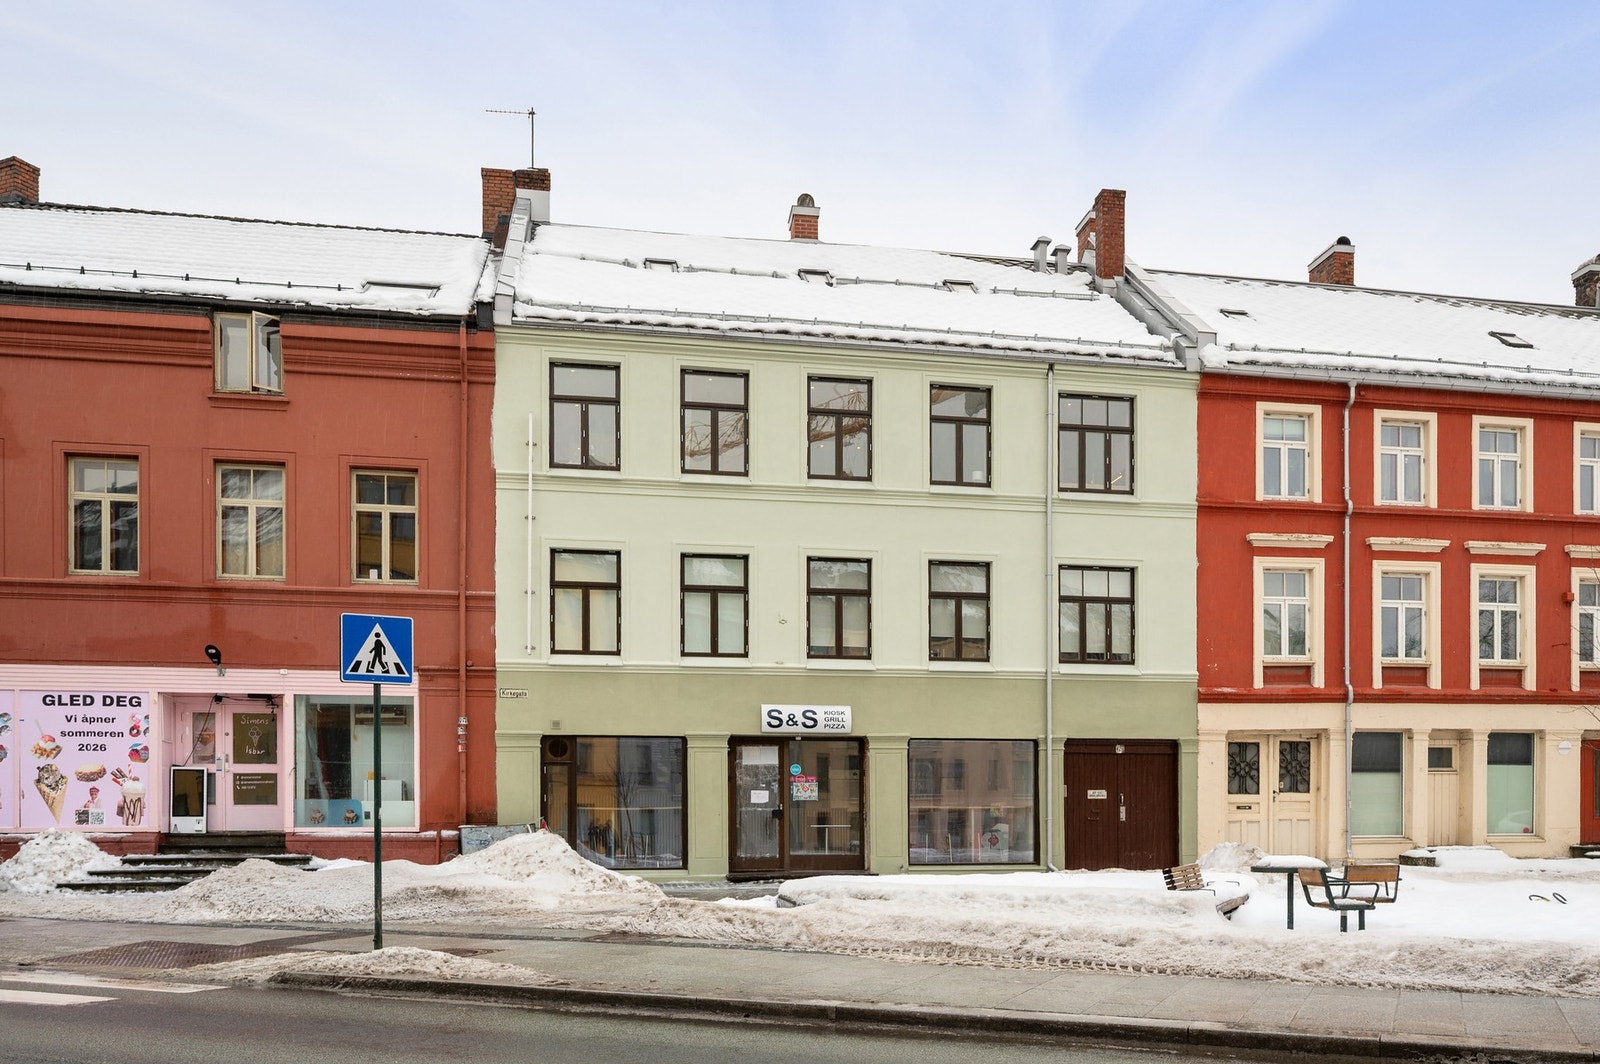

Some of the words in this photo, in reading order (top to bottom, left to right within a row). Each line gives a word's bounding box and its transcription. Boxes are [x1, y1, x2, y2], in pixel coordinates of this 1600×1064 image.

[42, 694, 95, 707] GLED
[102, 695, 142, 708] DEG
[65, 714, 77, 723] Vi
[81, 714, 116, 725] åpner
[240, 715, 269, 725] Simens
[766, 708, 819, 729] S&S
[60, 730, 124, 738] sommeren
[78, 743, 107, 752] 2026
[245, 746, 266, 755] Isbar
